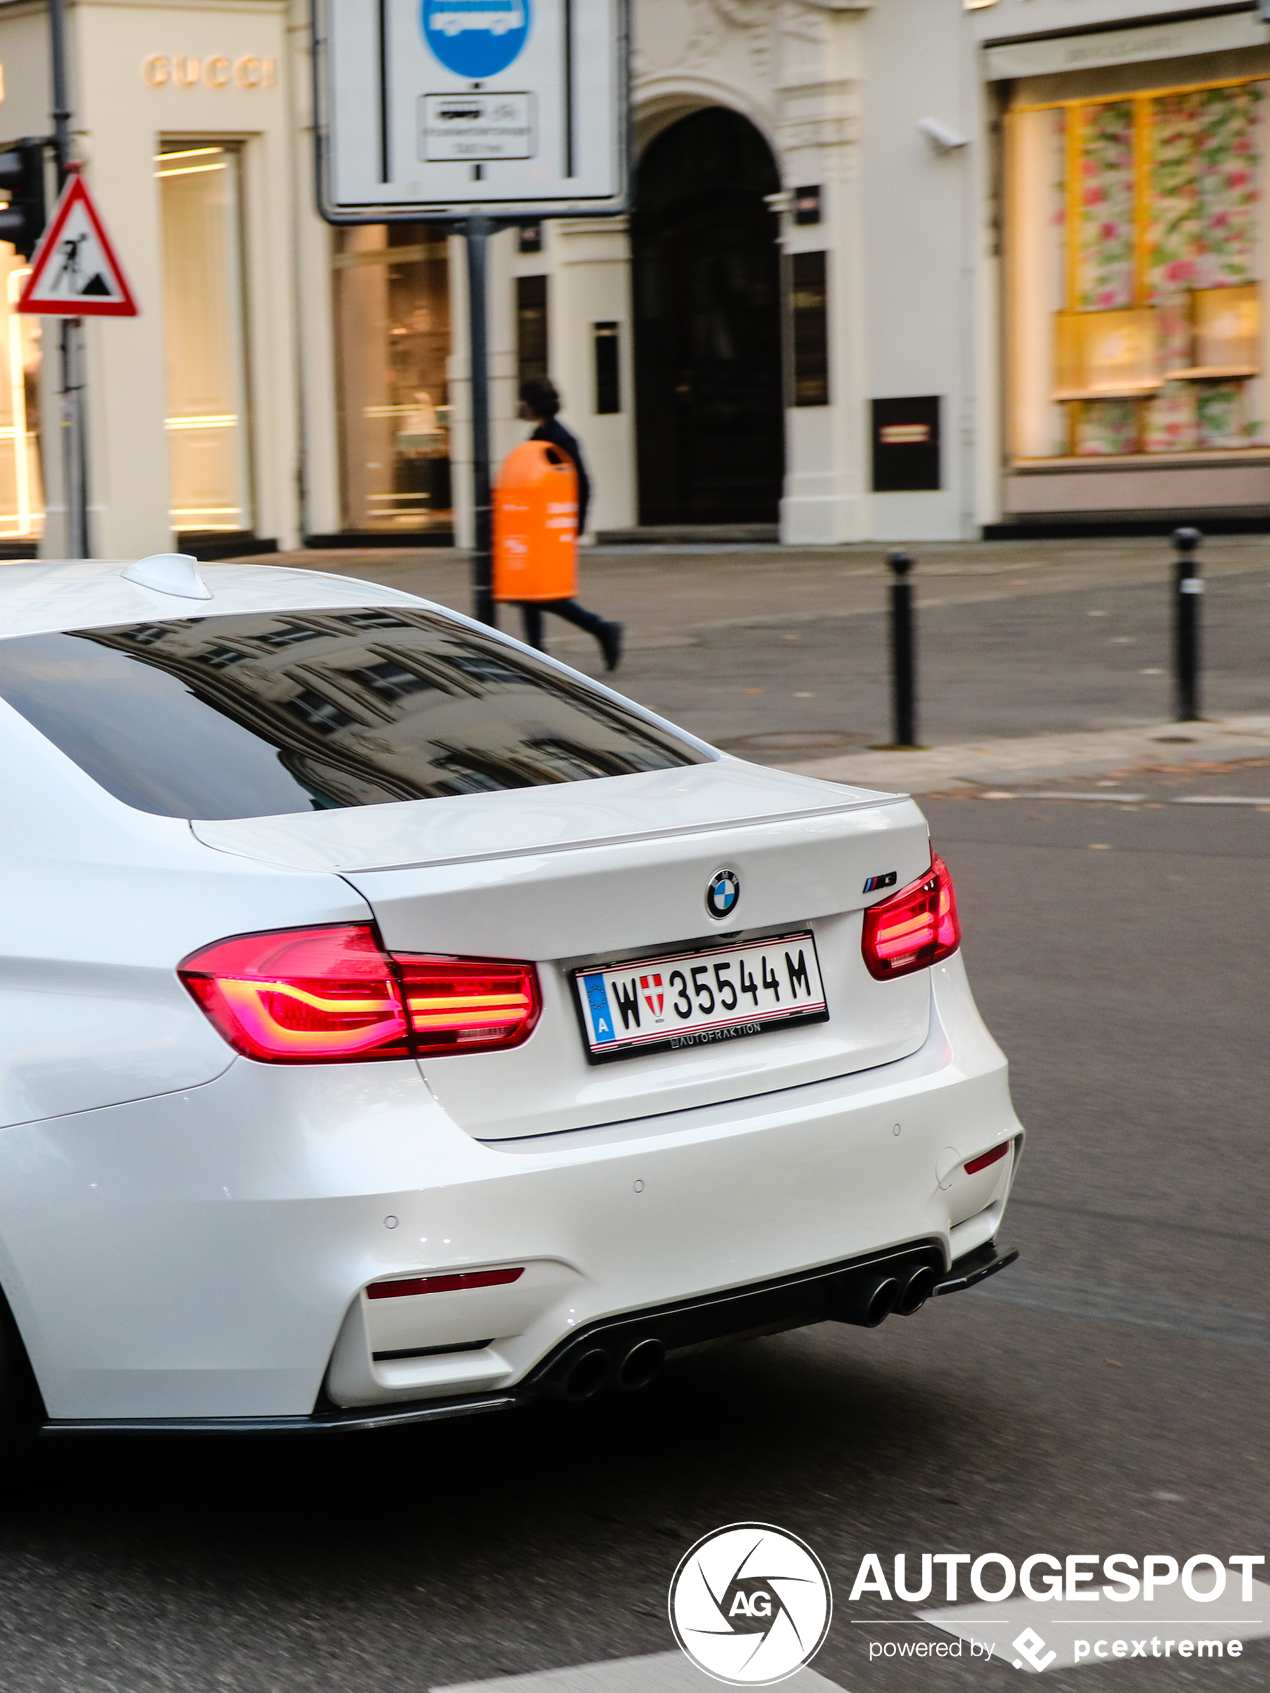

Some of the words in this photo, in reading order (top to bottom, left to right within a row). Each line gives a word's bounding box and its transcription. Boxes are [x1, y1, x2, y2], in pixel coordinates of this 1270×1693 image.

[143, 55, 276, 89] GUCCI
[612, 977, 641, 1030] W
[669, 956, 780, 1019] 35544
[785, 949, 811, 999] M
[598, 1017, 609, 1033] A
[679, 1022, 761, 1046] AUTOFRAKTION
